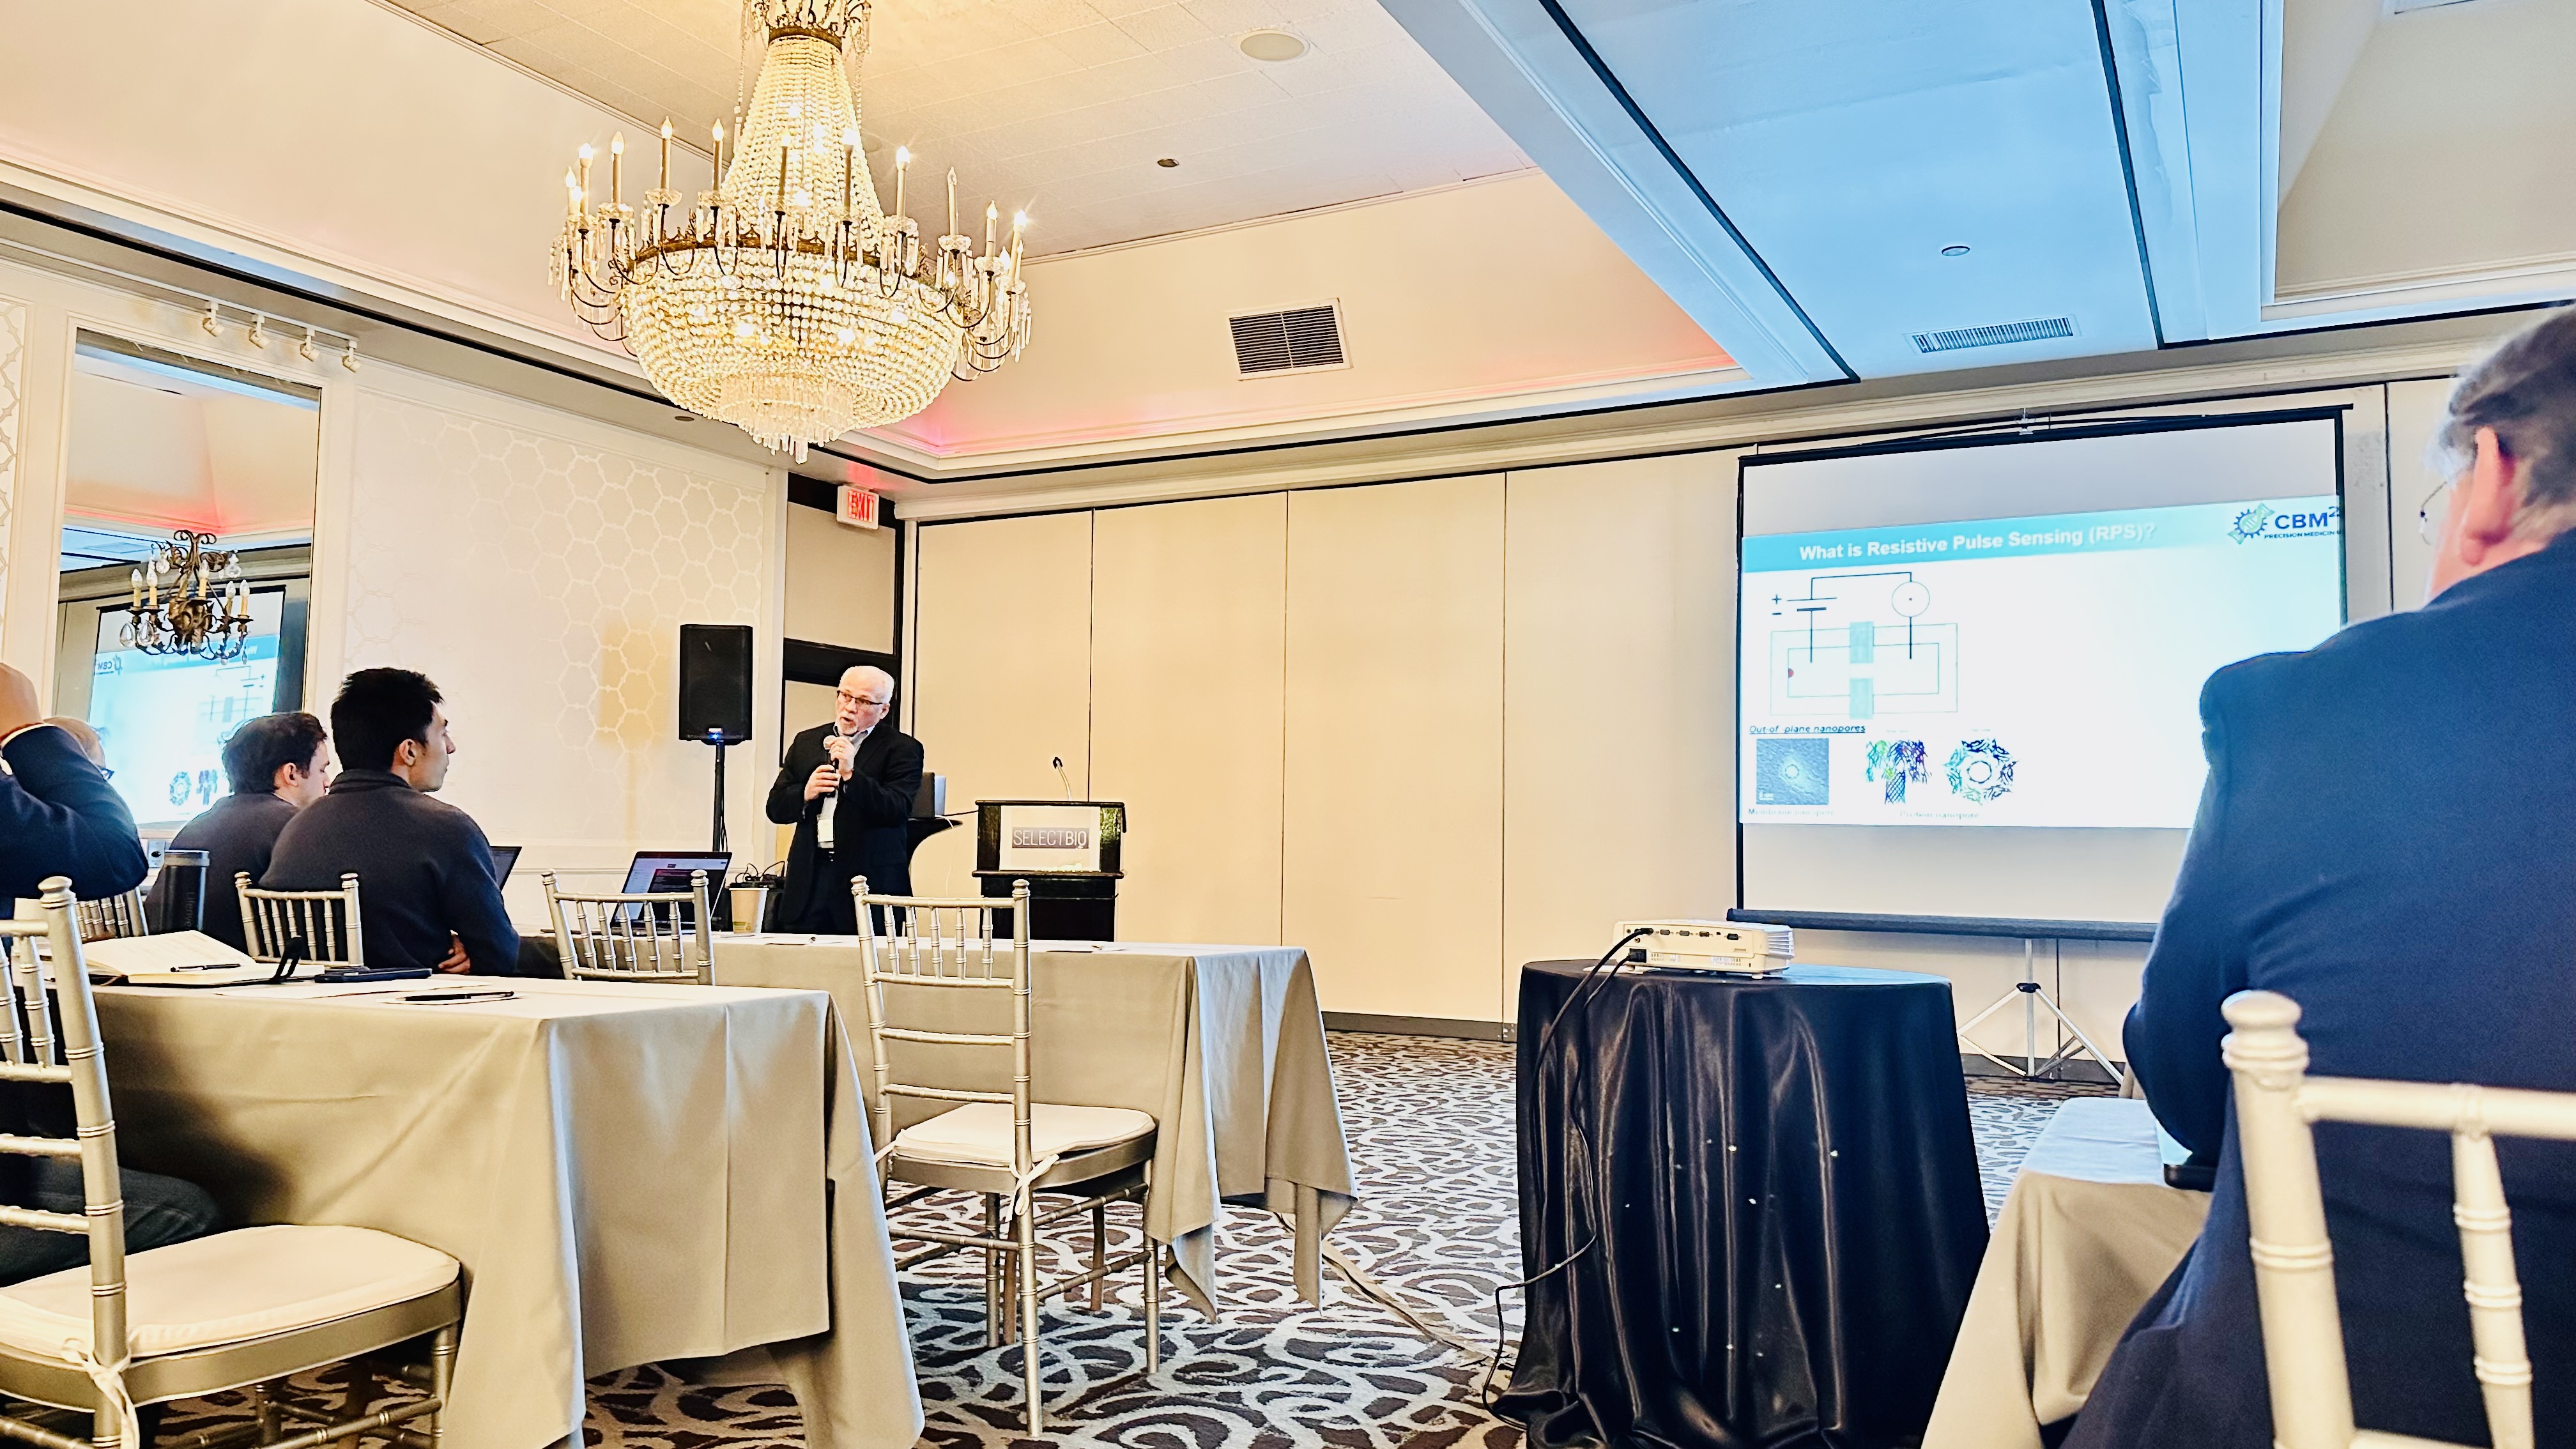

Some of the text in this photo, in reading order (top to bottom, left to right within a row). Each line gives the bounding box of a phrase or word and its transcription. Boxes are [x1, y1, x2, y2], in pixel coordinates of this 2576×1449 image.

[848, 490, 875, 523] EXIT
[1799, 523, 2156, 560] What is Resistive Pulse Sensing (RPS)?
[1814, 725, 1866, 733] nanopores
[1013, 830, 1087, 847] SELECTBIO
